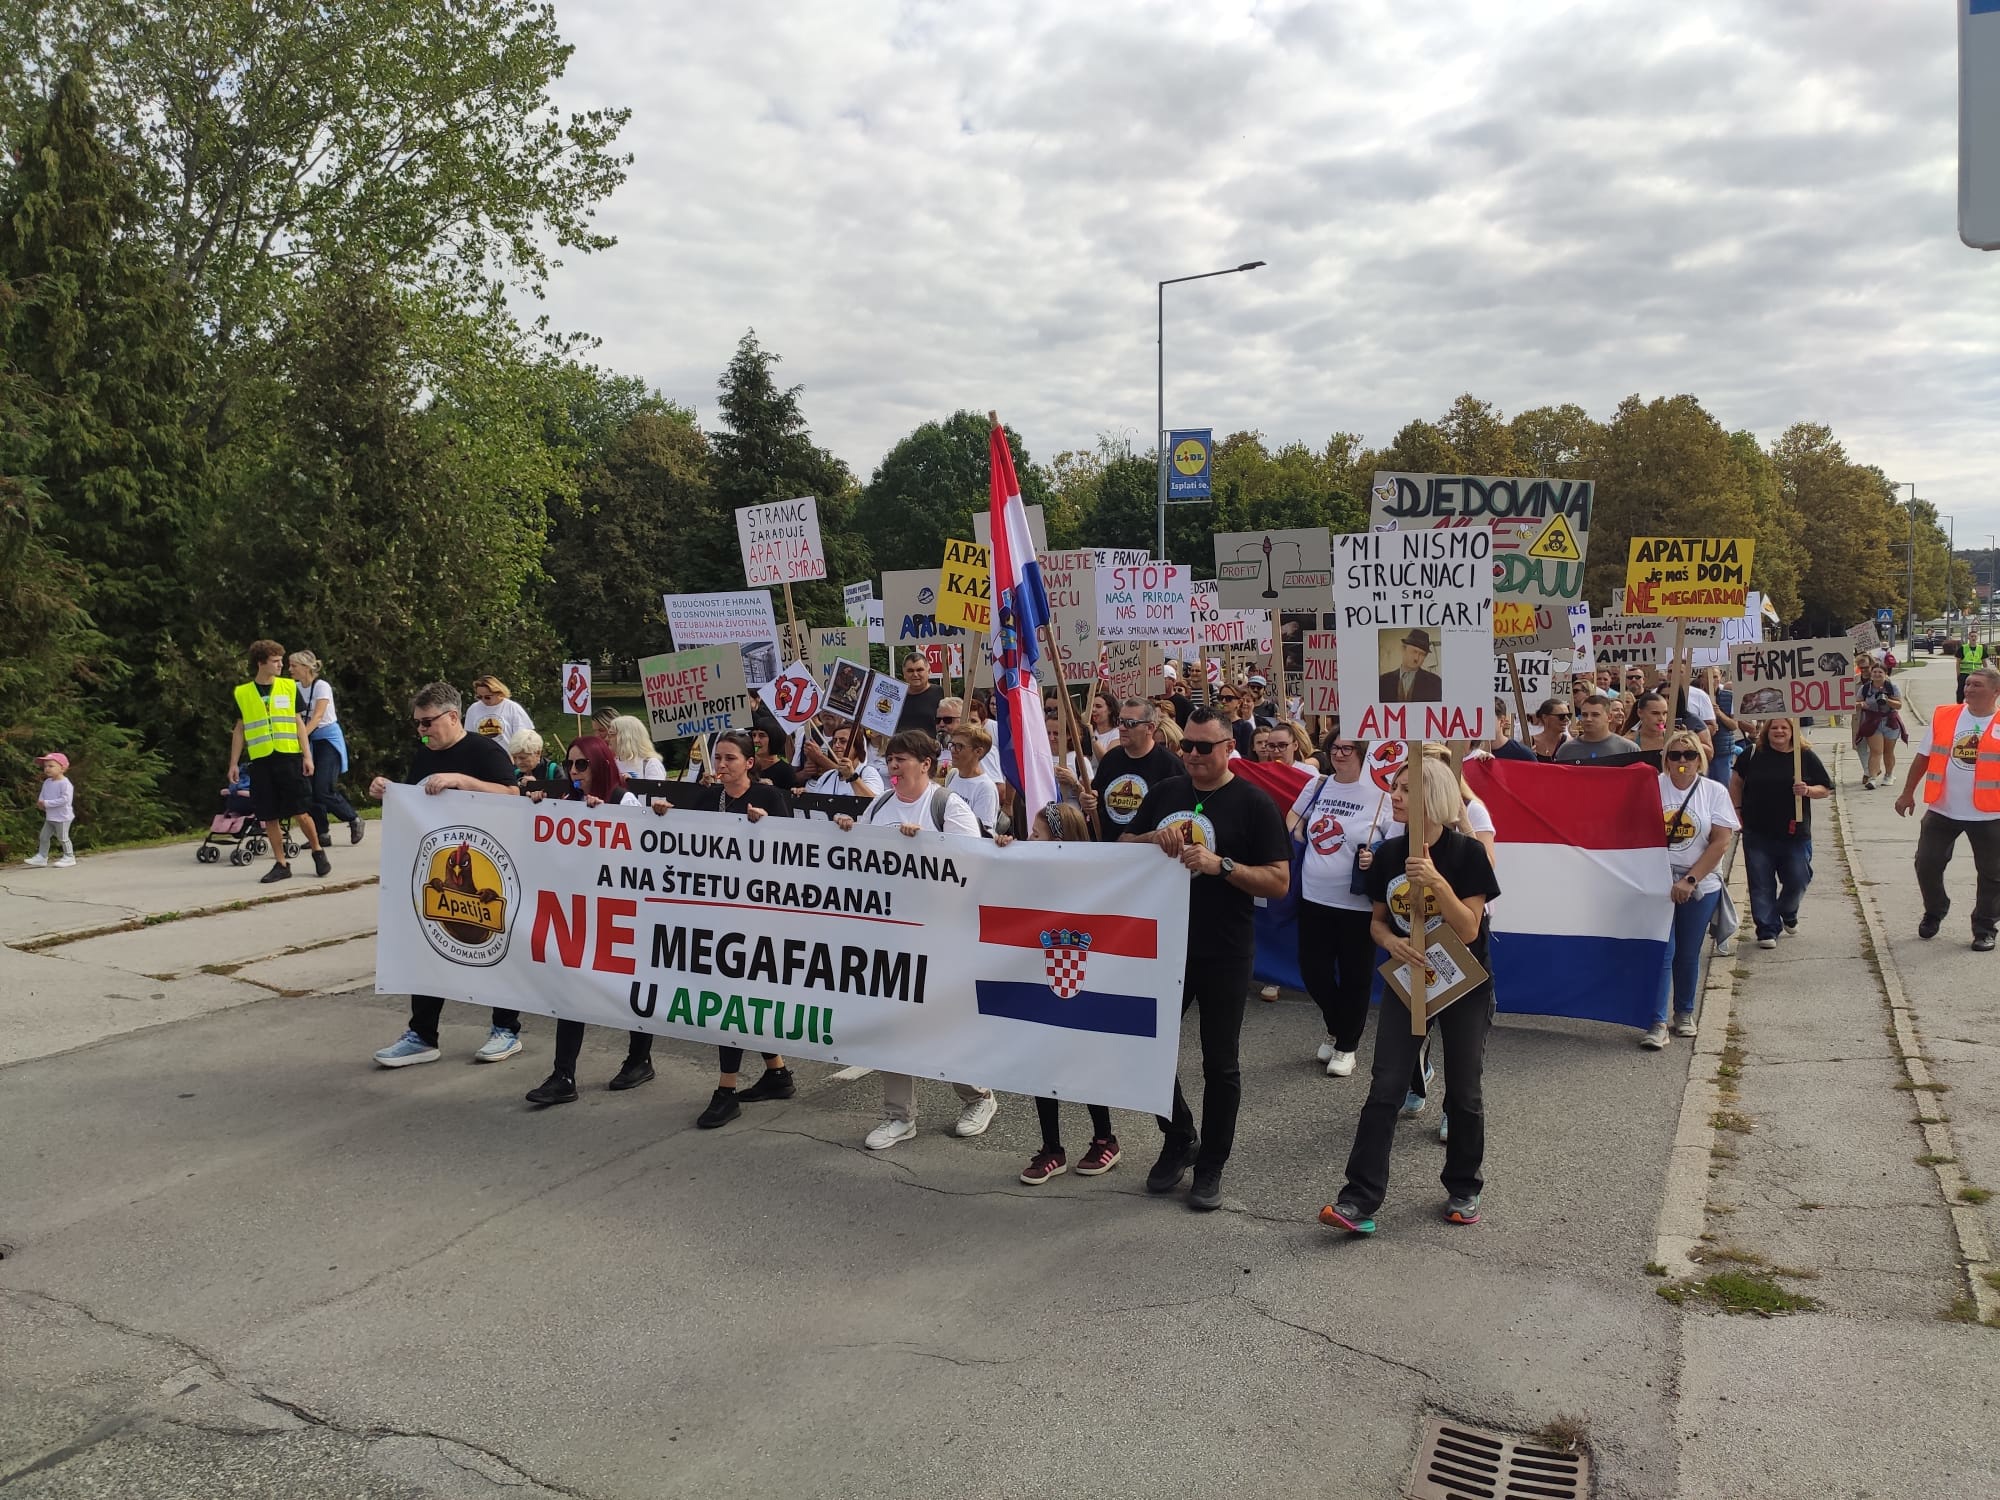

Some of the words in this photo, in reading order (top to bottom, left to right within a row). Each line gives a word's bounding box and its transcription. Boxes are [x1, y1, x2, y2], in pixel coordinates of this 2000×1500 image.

[1171, 481, 1197, 491] Isplati
[748, 504, 807, 527] STRANAC
[750, 539, 811, 565] APATIJA
[947, 543, 990, 568] APA
[1404, 532, 1489, 560] NISMO
[1636, 539, 1739, 563] APATIJA
[749, 565, 781, 583] GUTA
[787, 559, 825, 579] SMRAD
[1039, 554, 1092, 571] RUJETE
[1222, 565, 1257, 577] PROFIT
[1645, 568, 1662, 582] je
[1665, 566, 1689, 582] naš
[947, 573, 990, 599] KAŽ
[1113, 567, 1177, 590] STOP
[1348, 561, 1474, 590] STRUČNJACI
[732, 597, 762, 606] HRANA
[1049, 591, 1080, 608] ECU
[1105, 591, 1133, 604] NAŠA
[1142, 592, 1184, 603] PRIRODA
[1373, 591, 1386, 601] MI
[1402, 589, 1433, 600] SMO
[1626, 582, 1660, 613] NE
[672, 611, 681, 619] OD
[684, 609, 725, 618] OSNOVNIH
[726, 608, 767, 617] SIROVINA
[870, 616, 884, 626] PET
[1146, 604, 1173, 620] DOM
[1190, 610, 1218, 622] TKO
[822, 629, 846, 646] NAŠE
[1204, 622, 1245, 643] PROFIT
[1591, 620, 1622, 633] andati
[1308, 634, 1337, 650] NITK
[1592, 632, 1657, 646] PATIJA
[1595, 648, 1657, 663] AMTI!
[645, 666, 709, 692] KUPUJETE
[1305, 656, 1337, 681] ŽIVJE
[647, 685, 707, 708] TRUJETE
[1319, 687, 1338, 711] ZA
[1790, 678, 1856, 713] BOLE
[652, 702, 697, 725] PRLJAVI
[703, 695, 747, 716] PROFIT
[1357, 704, 1407, 739] AM
[1426, 705, 1482, 739] NAJ
[677, 714, 733, 737] SNUJETE
[423, 837, 438, 861] STOP
[443, 832, 477, 843] FARMI
[480, 838, 509, 872] PILIĆA
[534, 815, 632, 850] DOSTA
[639, 829, 740, 860] ODLUKA
[748, 838, 764, 862] U
[772, 841, 818, 868] IME
[826, 846, 966, 887] GRAĐANA,
[597, 864, 613, 886] A
[620, 866, 655, 890] NA
[661, 864, 738, 899] ŠTETU
[745, 879, 890, 916] GRAĐANA!
[438, 893, 491, 923] Apatija
[1398, 899, 1434, 913] Apja
[432, 928, 449, 948] SELO
[530, 889, 638, 975] NE
[651, 923, 928, 1004] MEGAFARMI
[629, 980, 657, 1018] U
[667, 987, 834, 1045] APATIJI!
